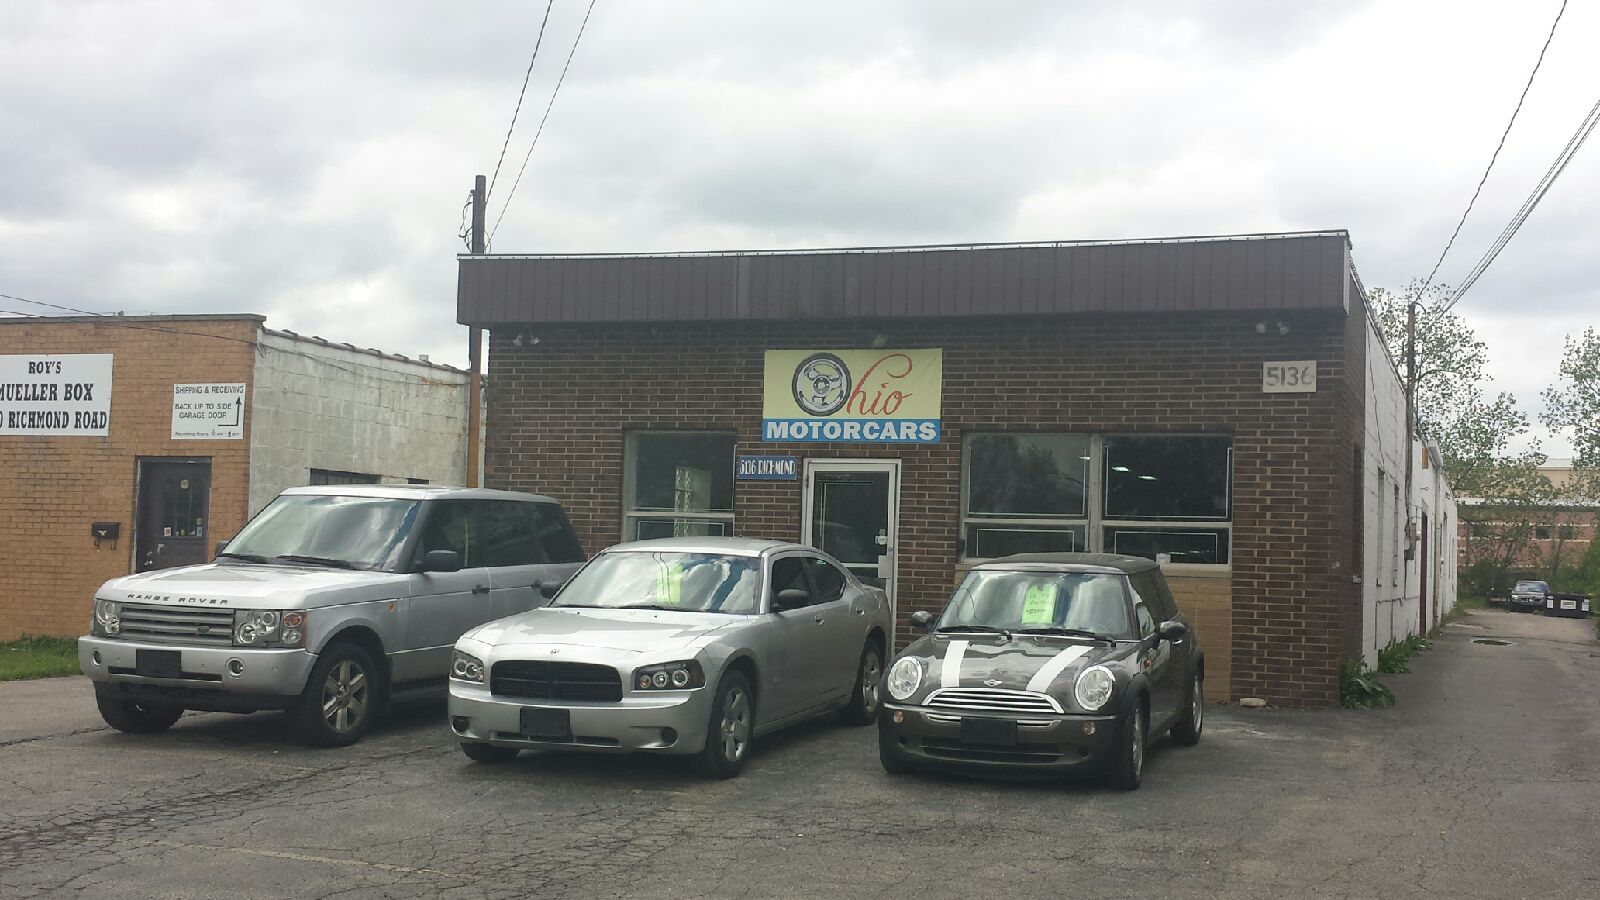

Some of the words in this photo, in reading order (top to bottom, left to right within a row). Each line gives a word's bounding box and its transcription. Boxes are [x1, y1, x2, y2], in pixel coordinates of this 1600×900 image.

[28, 361, 61, 374] ROY'S
[1266, 367, 1313, 386] 5136
[64, 383, 93, 401] BOX
[175, 386, 203, 394] SHIPPING
[204, 386, 209, 394] &
[211, 386, 244, 394] RECEIVING
[8, 411, 69, 429] RICHMOND
[74, 411, 107, 429] ROAD
[179, 411, 205, 419] GARAGE
[208, 411, 227, 419] DOOR
[767, 421, 936, 440] MOTORCARS
[127, 593, 171, 601] RANGE
[178, 597, 228, 605] ROVER
